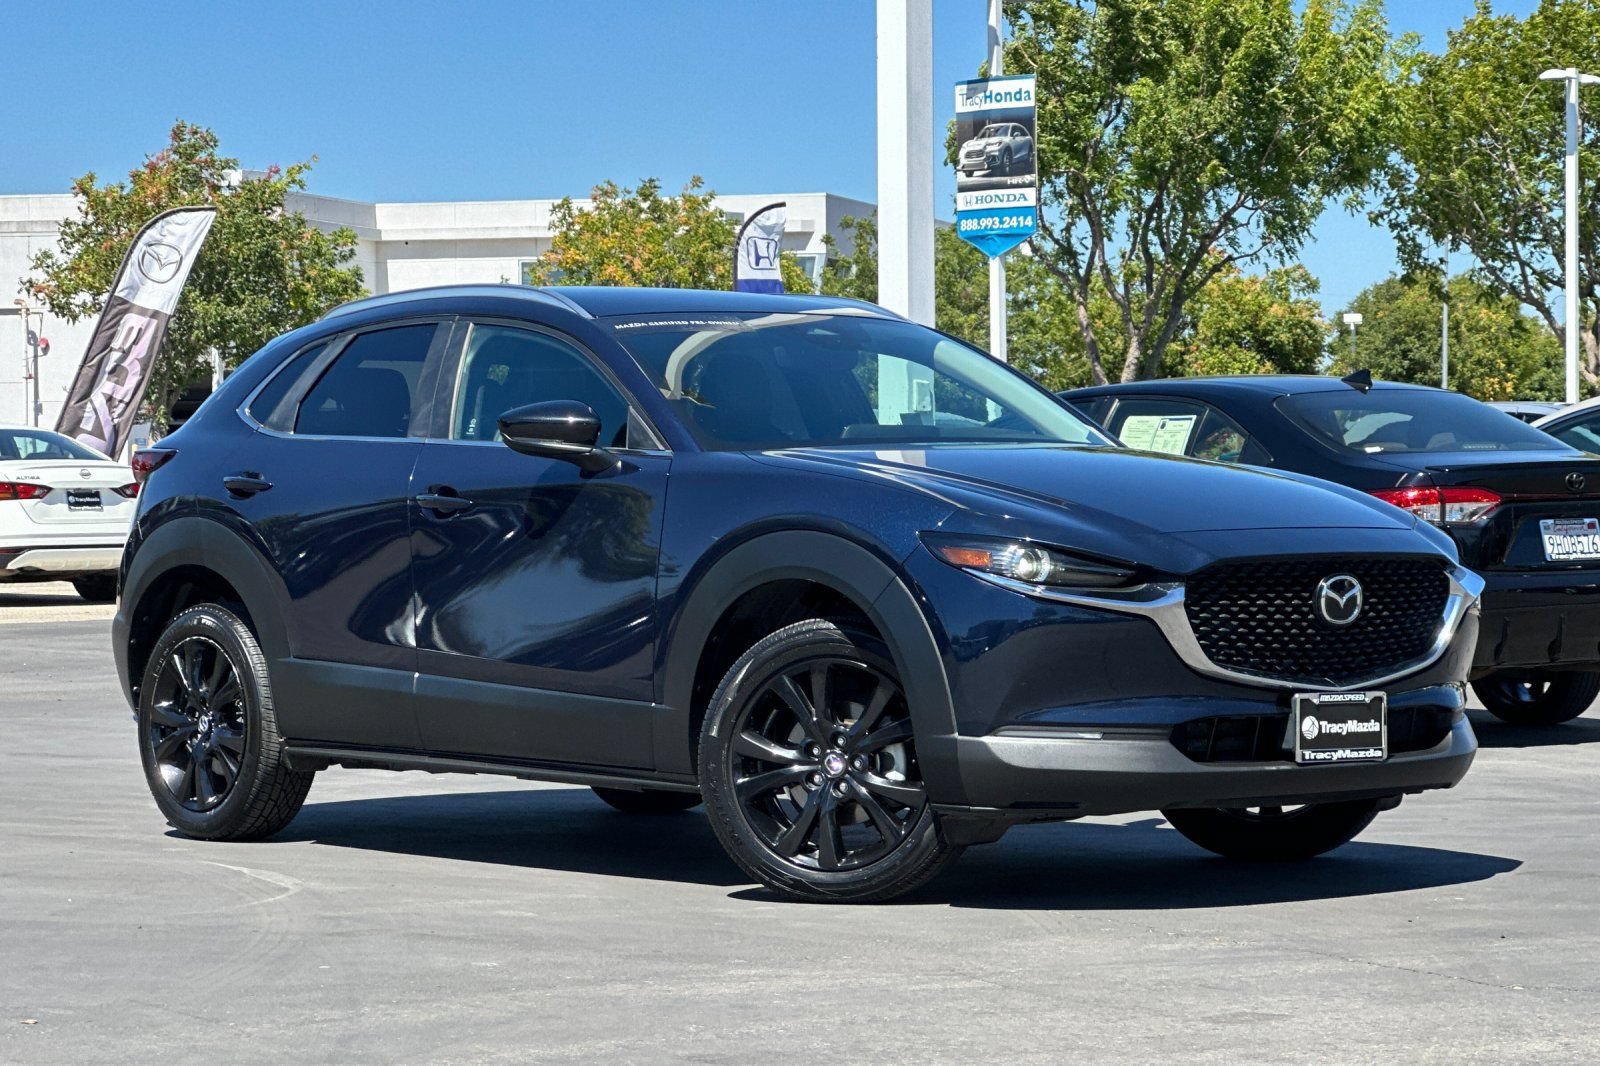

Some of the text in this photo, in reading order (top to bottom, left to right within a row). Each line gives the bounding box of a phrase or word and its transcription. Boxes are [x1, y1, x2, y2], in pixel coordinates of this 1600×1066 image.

[959, 87, 1032, 108] TracyHonda
[975, 193, 1029, 205] HONDA
[960, 216, 1033, 232] 888.993.2414
[614, 322, 648, 330] MAZDA
[1320, 694, 1364, 702] MAZDASPEED
[1319, 719, 1381, 735] TracyMazda
[1303, 748, 1383, 761] TracyMazda
